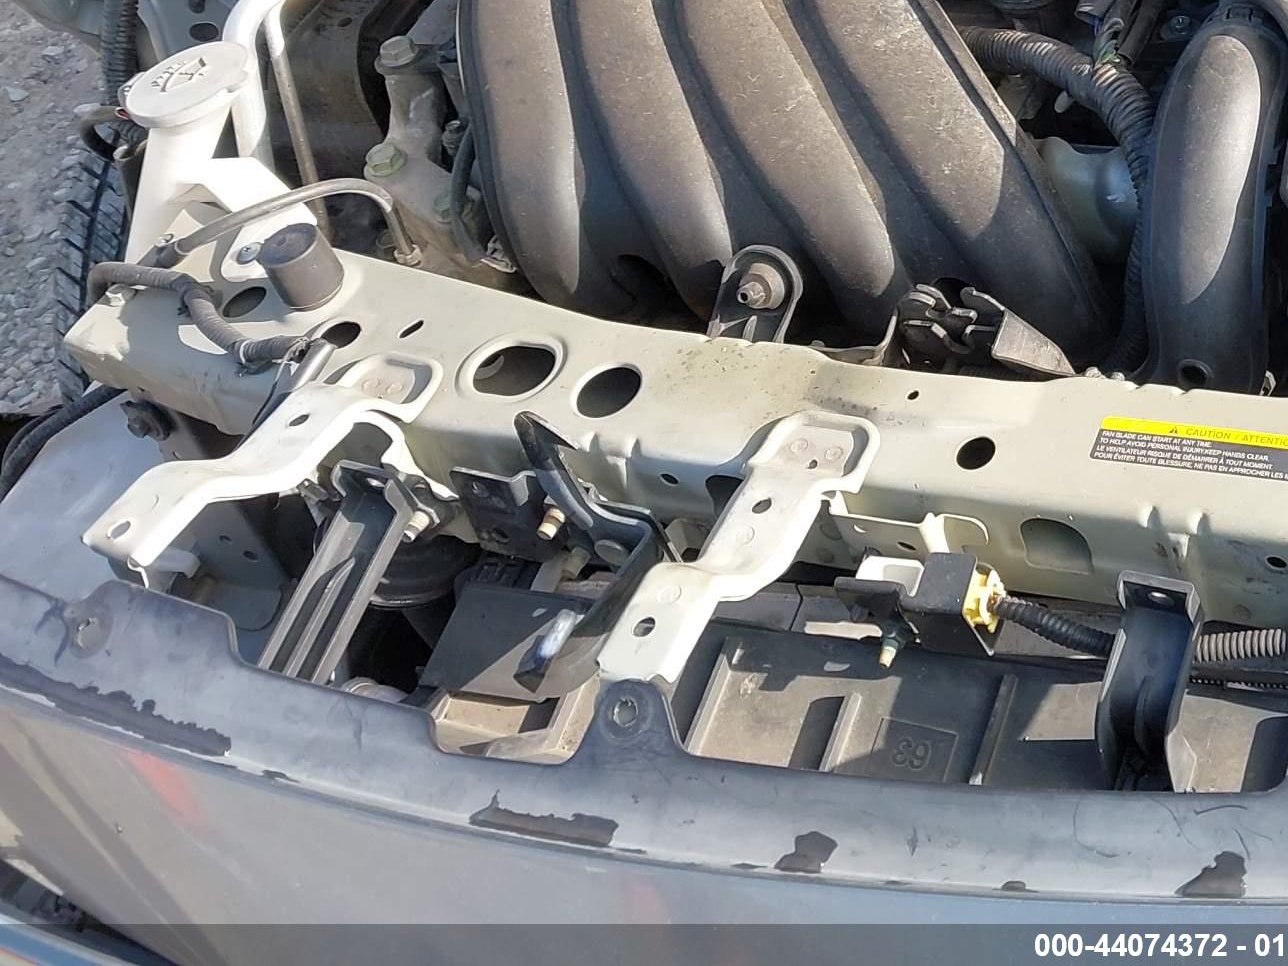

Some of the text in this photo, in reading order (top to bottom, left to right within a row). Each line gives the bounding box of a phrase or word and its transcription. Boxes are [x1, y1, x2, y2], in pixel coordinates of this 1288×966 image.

[1102, 430, 1114, 438] FAN
[1152, 435, 1172, 443] START
[1182, 438, 1195, 446] ANY
[1185, 428, 1231, 440] CAUTION
[1109, 438, 1127, 446] HELP
[1126, 440, 1146, 448] AVOID
[1147, 442, 1184, 452] PERSONAL
[1222, 449, 1246, 459] HANDS
[1094, 451, 1112, 459] POUR
[1136, 456, 1157, 464] TOUTE
[1194, 462, 1203, 470] NE
[1204, 464, 1217, 472] PAS
[1218, 465, 1228, 473] EN
[1271, 471, 1284, 479] LES
[1147, 450, 1172, 458] RISQUE
[1172, 452, 1181, 460] DE
[1225, 459, 1243, 467] TOUT
